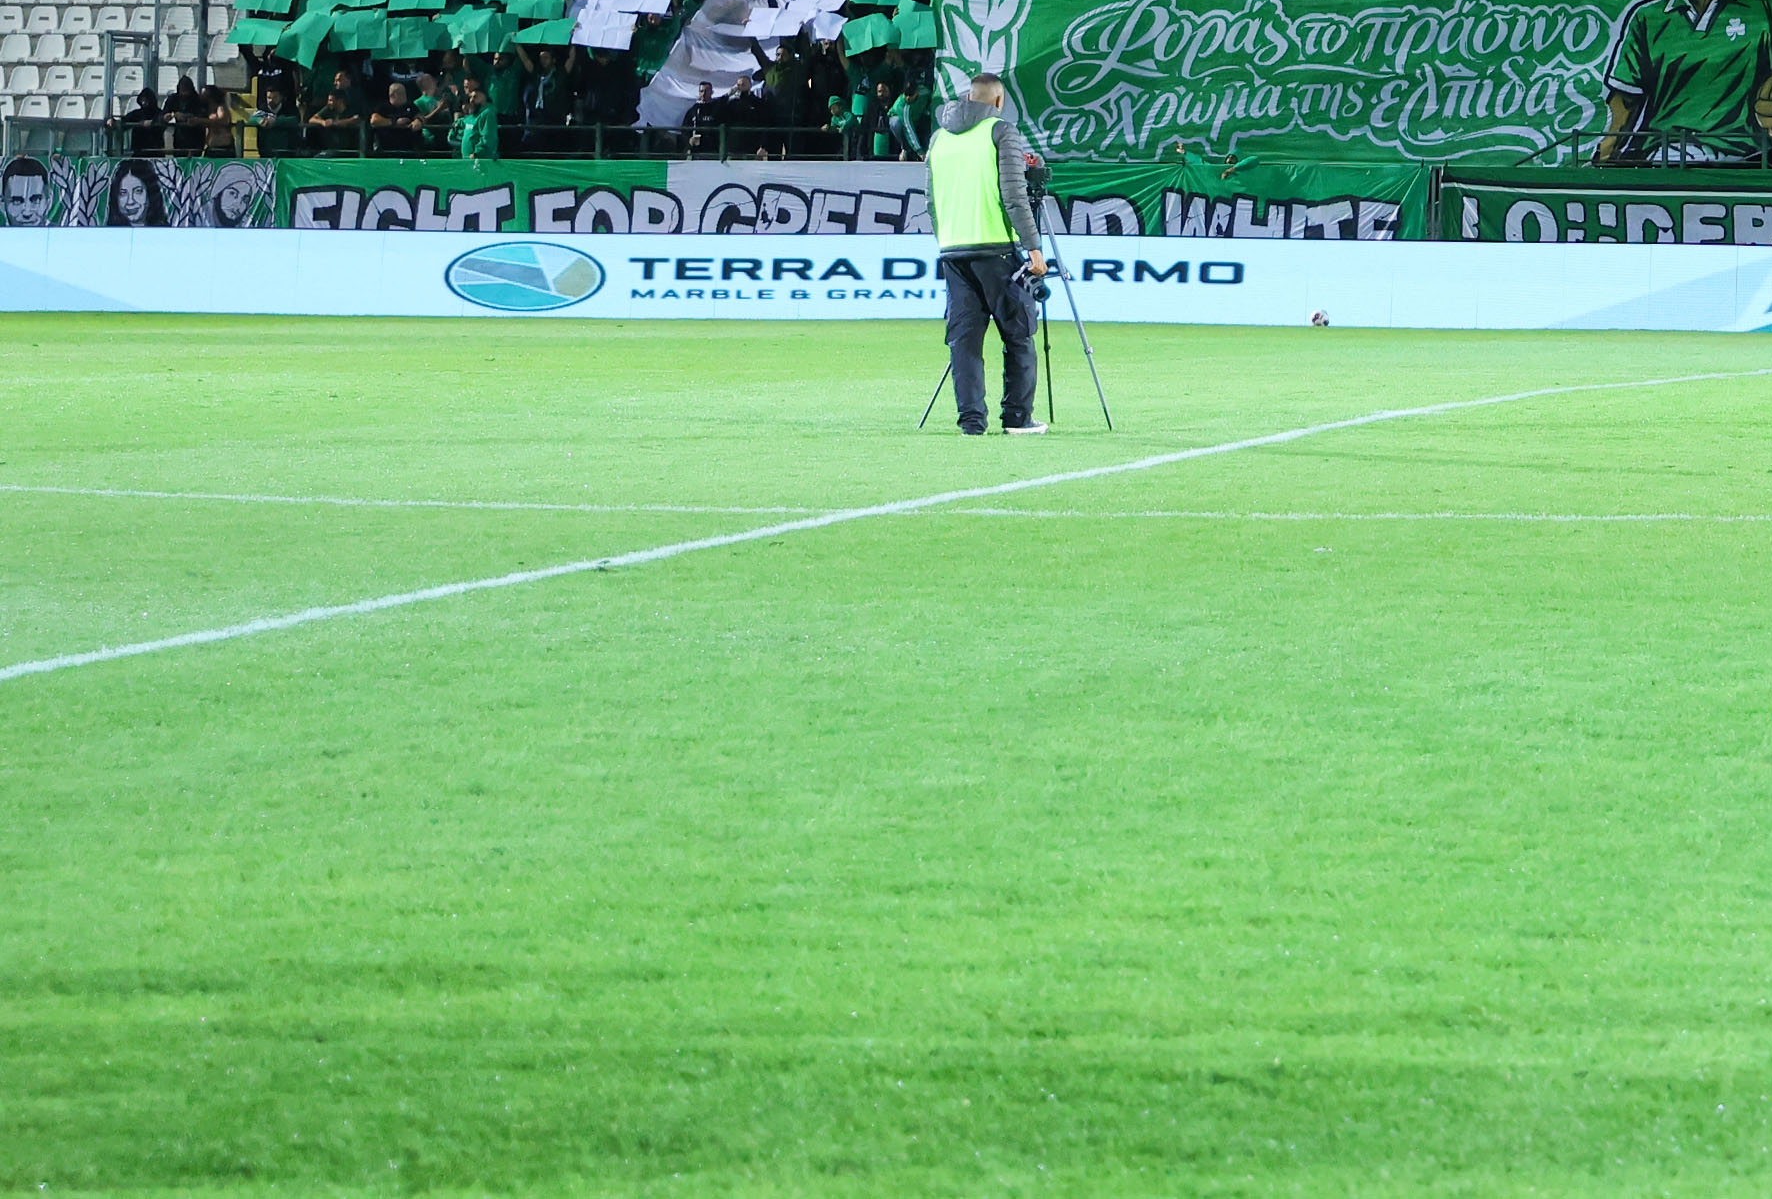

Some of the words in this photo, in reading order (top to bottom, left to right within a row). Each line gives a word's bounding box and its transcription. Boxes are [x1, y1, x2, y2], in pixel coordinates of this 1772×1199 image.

[529, 185, 684, 234] FOR
[629, 257, 864, 281] TERRA
[631, 289, 776, 300] MARBLE
[790, 289, 811, 300] &
[826, 289, 947, 301] GRANI
